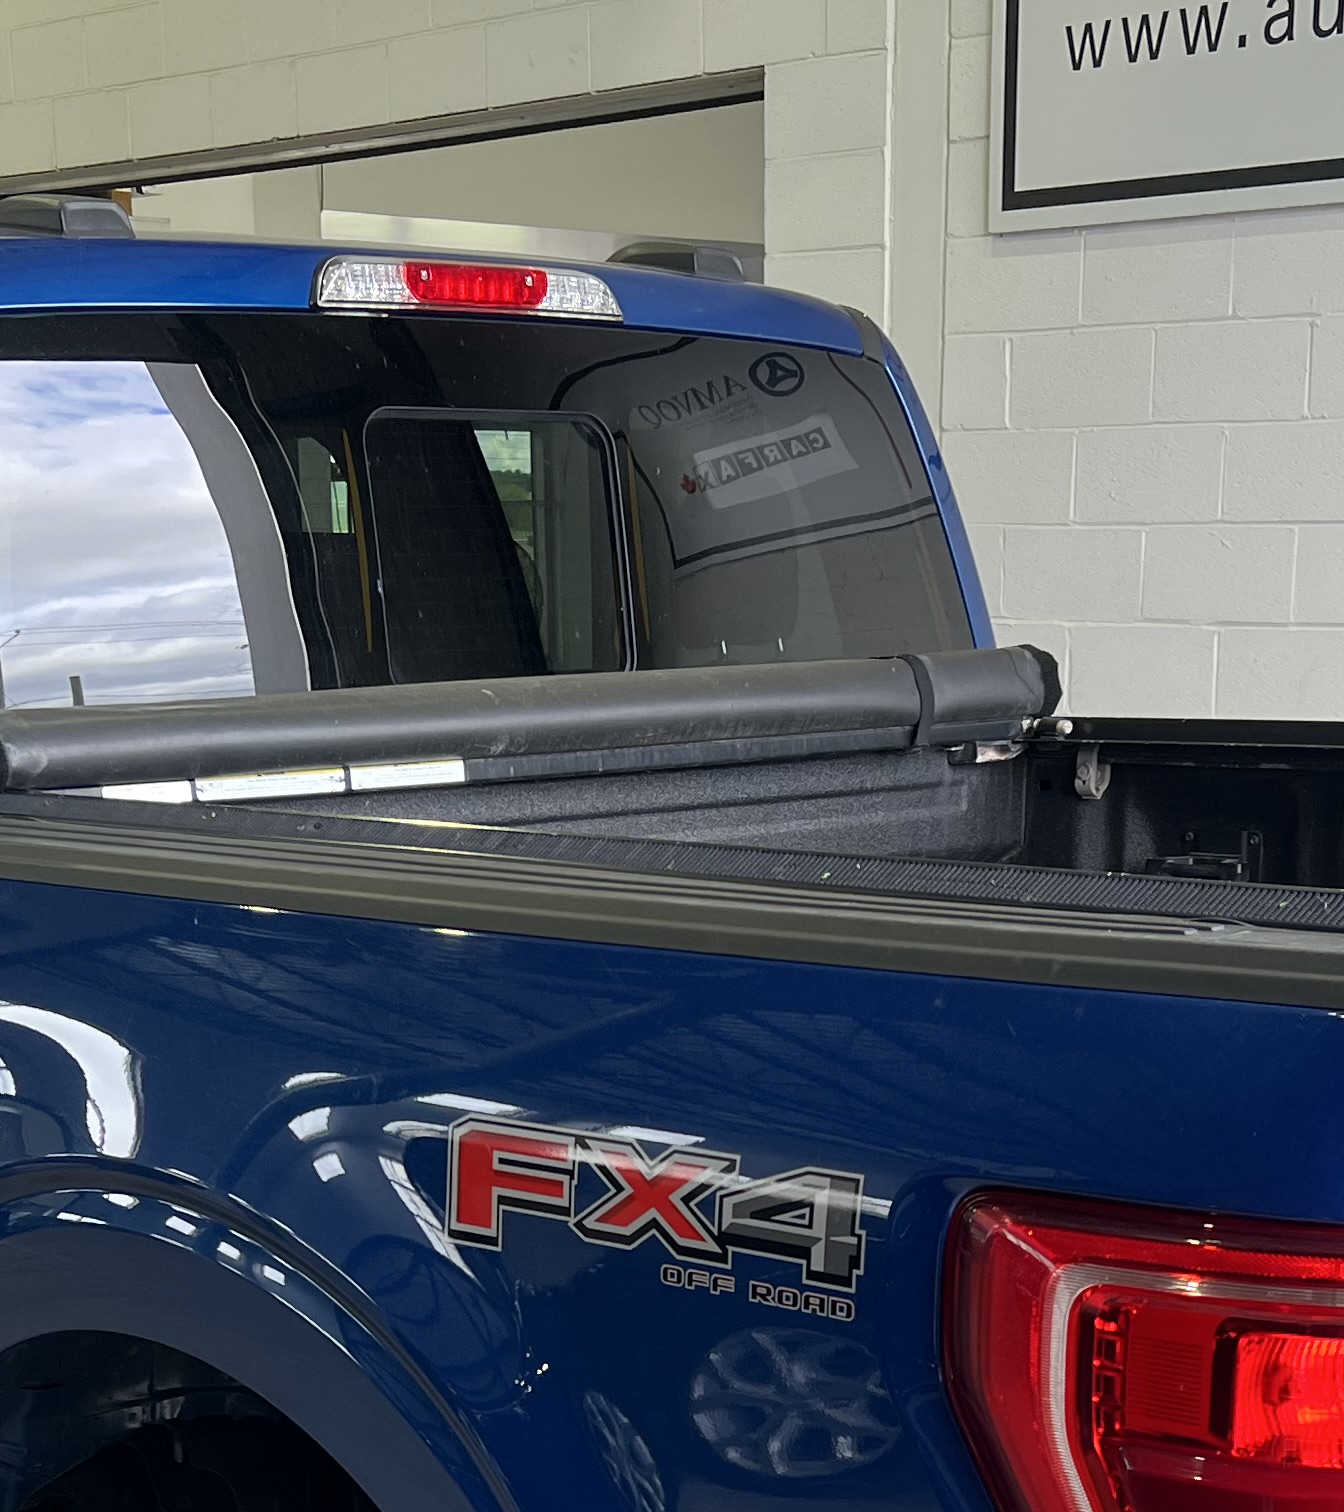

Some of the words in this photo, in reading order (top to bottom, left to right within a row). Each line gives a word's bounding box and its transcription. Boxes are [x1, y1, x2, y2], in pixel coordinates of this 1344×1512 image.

[445, 1114, 866, 1293] FX4
[660, 1263, 736, 1296] OFF
[748, 1280, 856, 1323] ROAD
